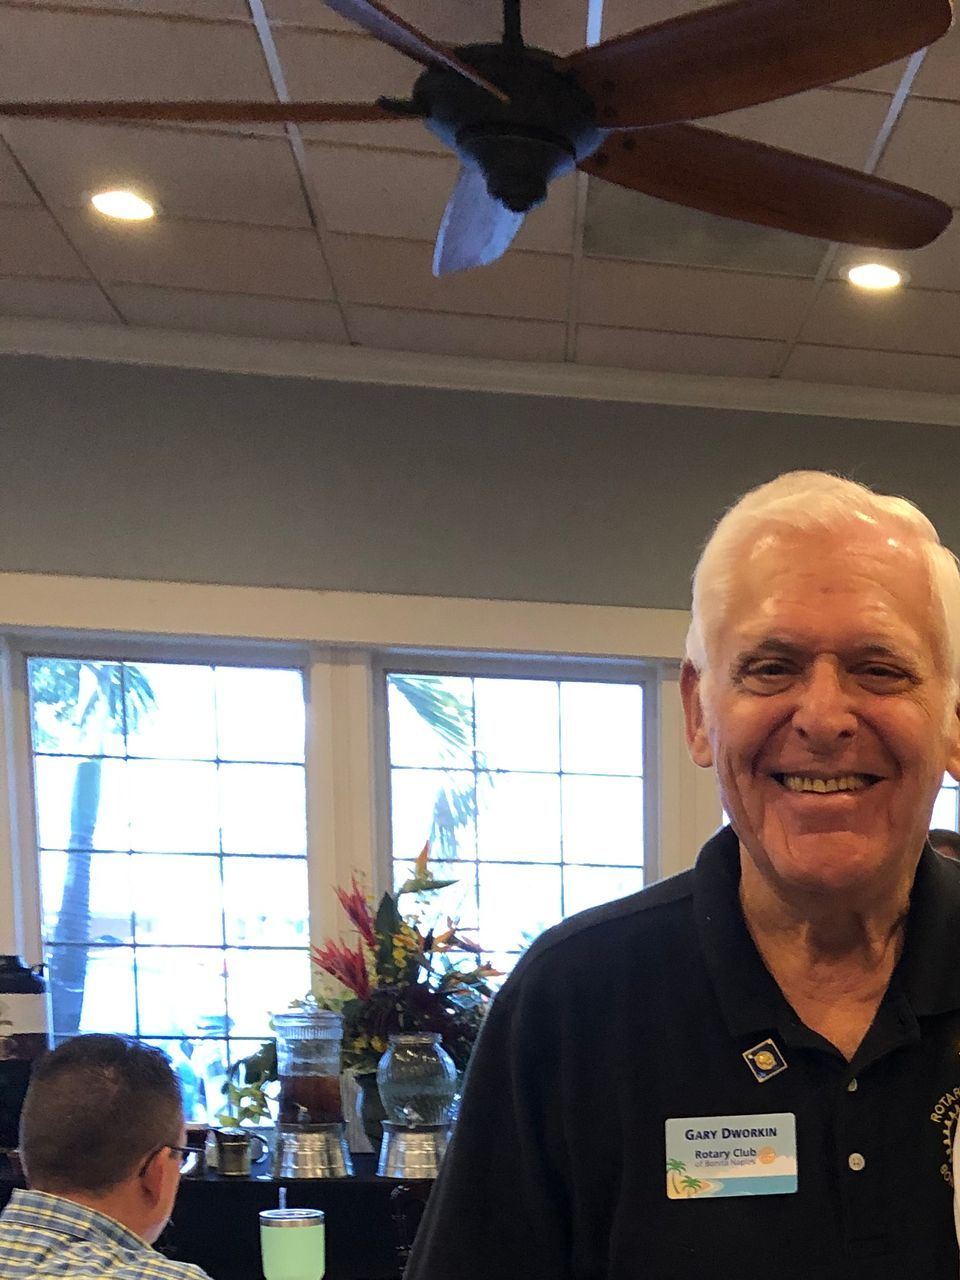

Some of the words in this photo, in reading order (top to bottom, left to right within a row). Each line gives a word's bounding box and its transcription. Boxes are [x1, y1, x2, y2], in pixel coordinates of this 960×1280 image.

[684, 1128, 718, 1141] GARY
[721, 1127, 778, 1139] DWORKIN
[695, 1150, 730, 1161] Rotary
[732, 1148, 757, 1158] Club
